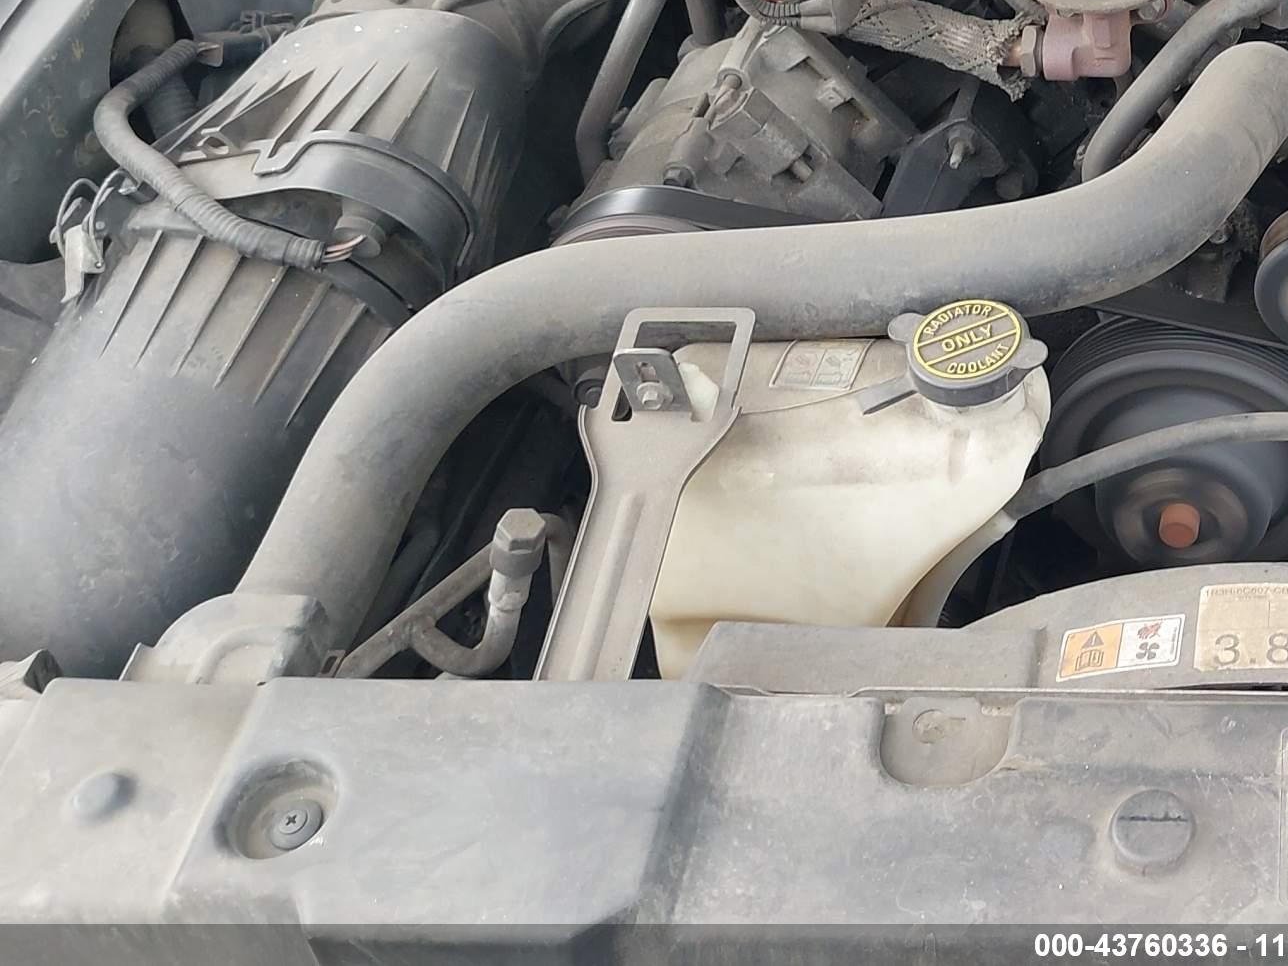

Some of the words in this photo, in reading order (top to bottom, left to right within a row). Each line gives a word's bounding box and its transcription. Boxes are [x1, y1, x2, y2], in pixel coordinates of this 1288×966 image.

[923, 304, 992, 335] RADIATOR
[941, 323, 992, 352] ONLY
[946, 342, 1010, 374] COOLANT
